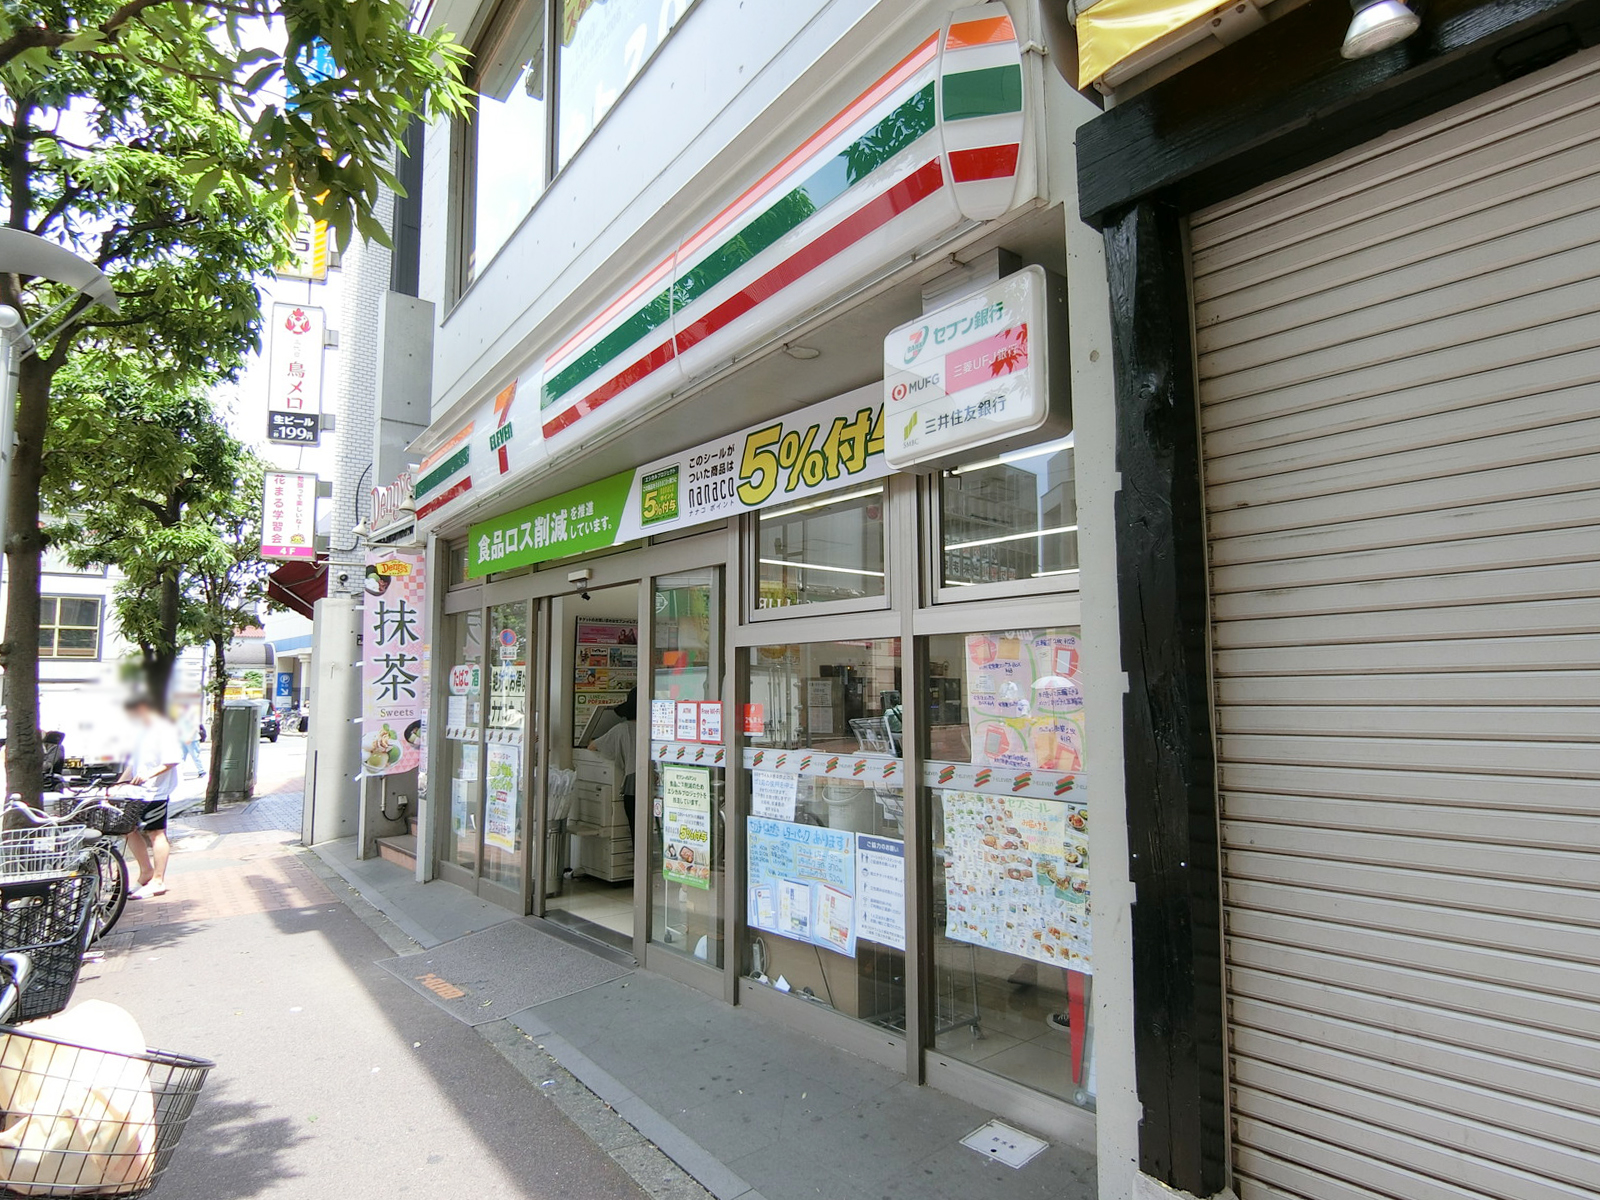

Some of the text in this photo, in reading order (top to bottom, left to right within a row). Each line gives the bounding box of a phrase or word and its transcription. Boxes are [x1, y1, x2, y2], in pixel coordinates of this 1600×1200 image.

[933, 300, 1004, 345] セブン銀行
[953, 343, 1018, 377] 三菱UFJ銀行
[286, 361, 305, 410] 鳥メロ
[908, 372, 940, 394] MUFG
[273, 415, 315, 434] 生ビール
[924, 395, 1007, 435] 三井住友銀行
[903, 437, 919, 448] SMBC
[688, 443, 735, 469] このシールが
[688, 460, 735, 484] ついた商品は
[643, 490, 676, 518] 5%付与
[688, 476, 735, 508] nanaco
[271, 474, 286, 543] 花まる学習会
[570, 500, 594, 520] を推進
[688, 499, 735, 517] ナナコ ポイント
[477, 508, 568, 565] 食品ロス削減
[570, 515, 613, 540] しています。
[381, 563, 408, 574] Denny's
[372, 599, 420, 701] 抹茶
[453, 669, 469, 687] たばこ
[380, 707, 415, 717] Sweets
[866, 840, 900, 853] ご協力のお願い
